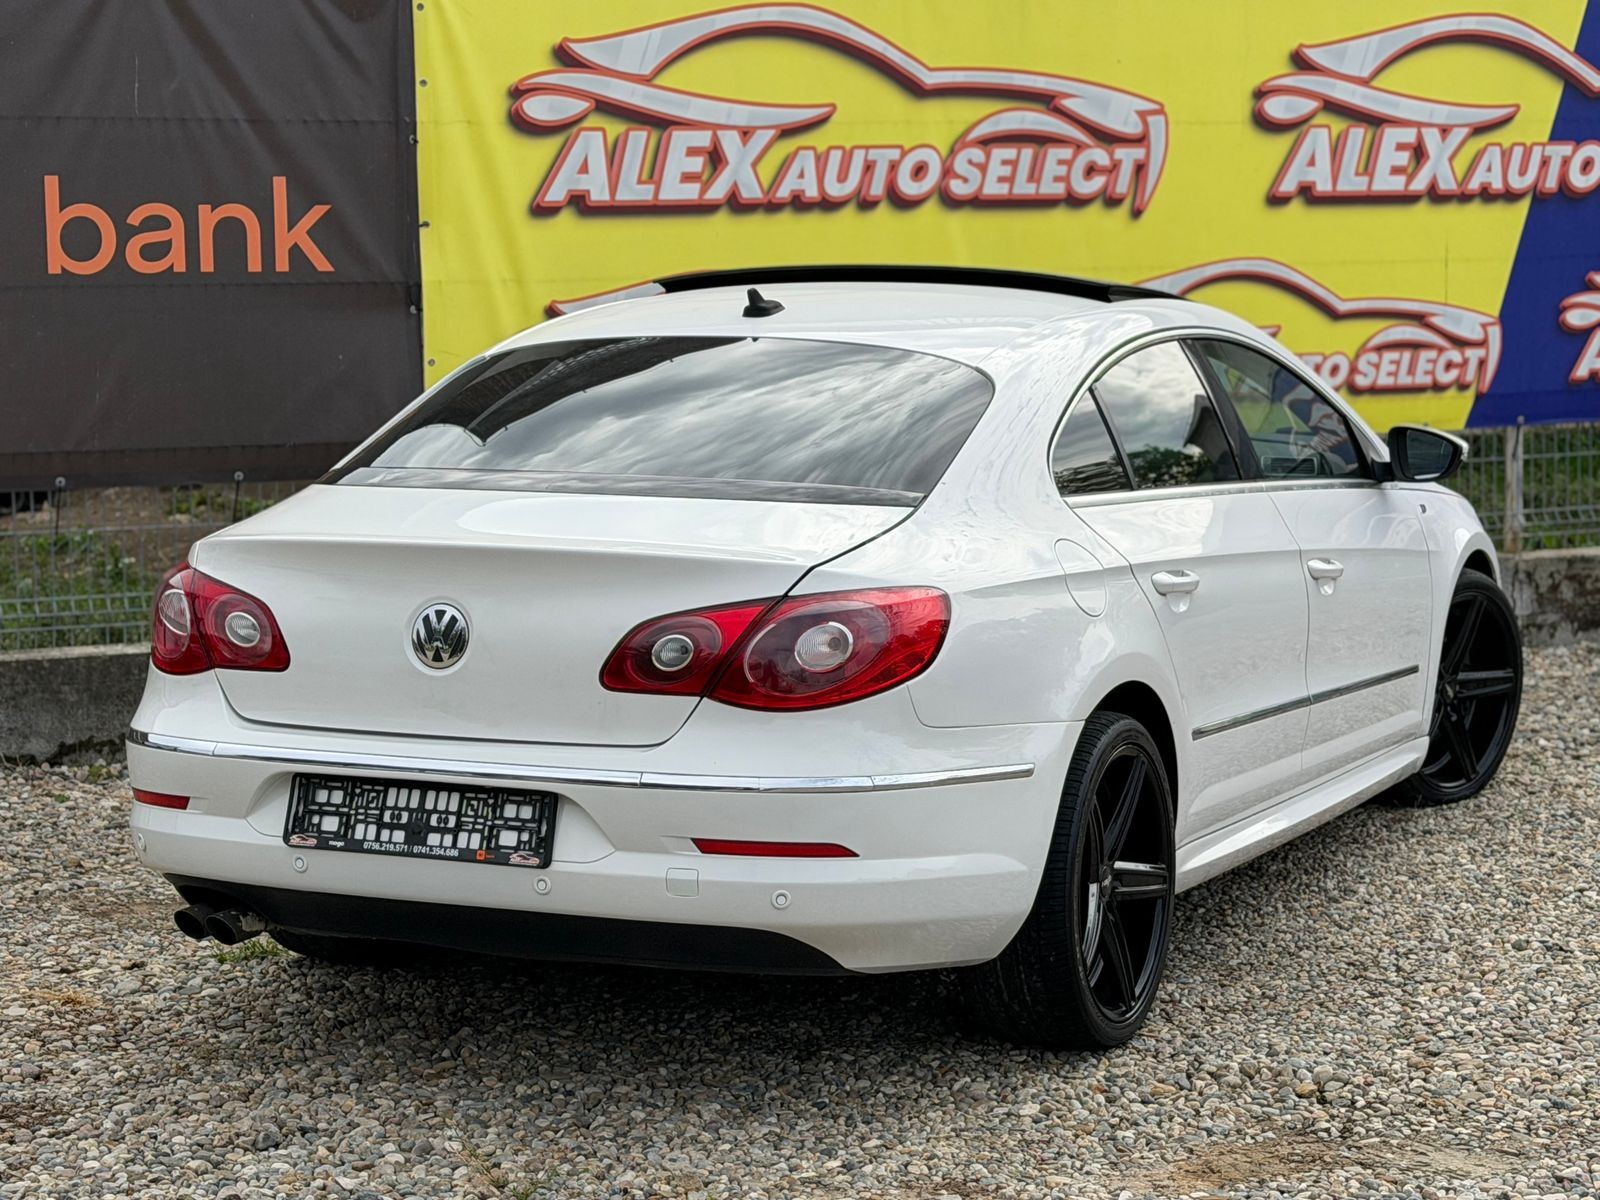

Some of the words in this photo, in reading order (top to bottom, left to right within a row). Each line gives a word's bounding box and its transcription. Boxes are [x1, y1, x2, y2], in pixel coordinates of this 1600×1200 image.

[536, 126, 775, 206] ALEX
[769, 144, 944, 204] AUTO
[946, 144, 1148, 202] SELECT
[1271, 124, 1472, 197] ALEX
[1463, 143, 1600, 196] AUTO
[44, 175, 336, 275] bank
[1351, 350, 1487, 390] SELECT
[363, 841, 408, 853] 0756.219.571
[413, 845, 459, 857] 0741.354.686
